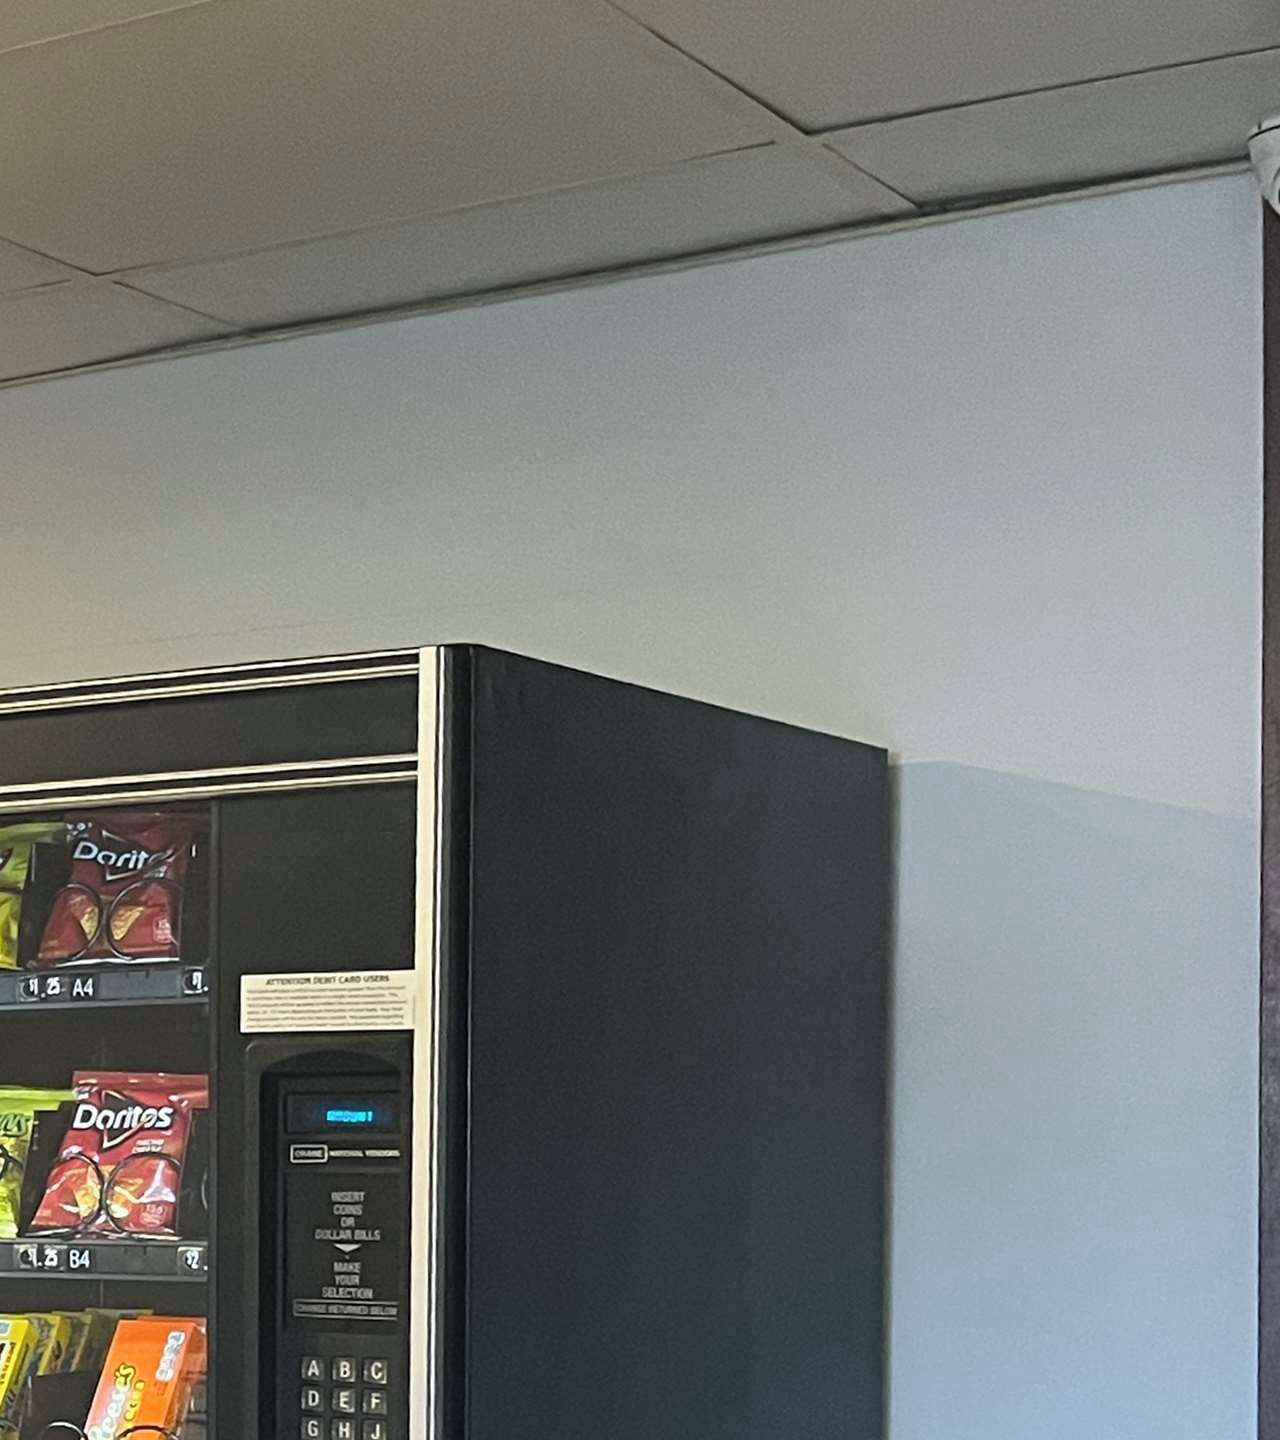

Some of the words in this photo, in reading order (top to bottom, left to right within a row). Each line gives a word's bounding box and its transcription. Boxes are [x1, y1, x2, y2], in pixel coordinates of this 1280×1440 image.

[338, 976, 361, 984] CARD
[363, 975, 390, 983] USERS
[72, 978, 94, 998] A4
[72, 1102, 175, 1130] Doritos
[331, 1192, 365, 1202] INSERT
[333, 1204, 363, 1215] COINS
[340, 1216, 355, 1227] OR
[315, 1228, 352, 1239] DOLLAR
[354, 1230, 381, 1240] BILLS
[69, 1250, 91, 1269] B4
[333, 1262, 361, 1273] MAKE
[334, 1275, 359, 1286] YOUR
[321, 1287, 373, 1299] SELECTION
